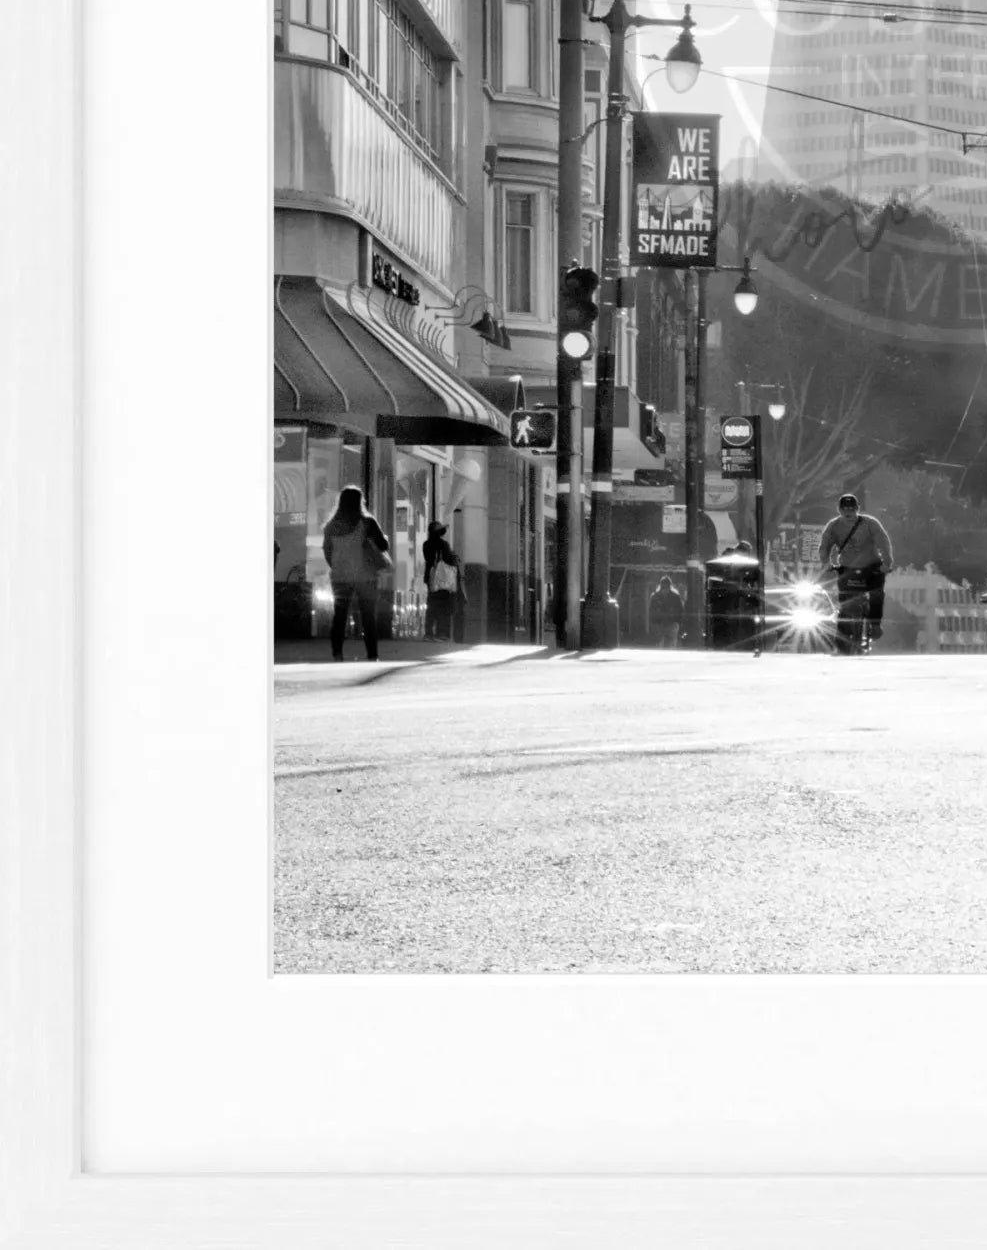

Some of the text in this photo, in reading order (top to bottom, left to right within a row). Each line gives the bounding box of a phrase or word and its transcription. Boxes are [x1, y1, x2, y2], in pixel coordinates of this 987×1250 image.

[677, 127, 711, 154] WE
[667, 155, 711, 181] ARE
[637, 233, 710, 257] SFMADE
